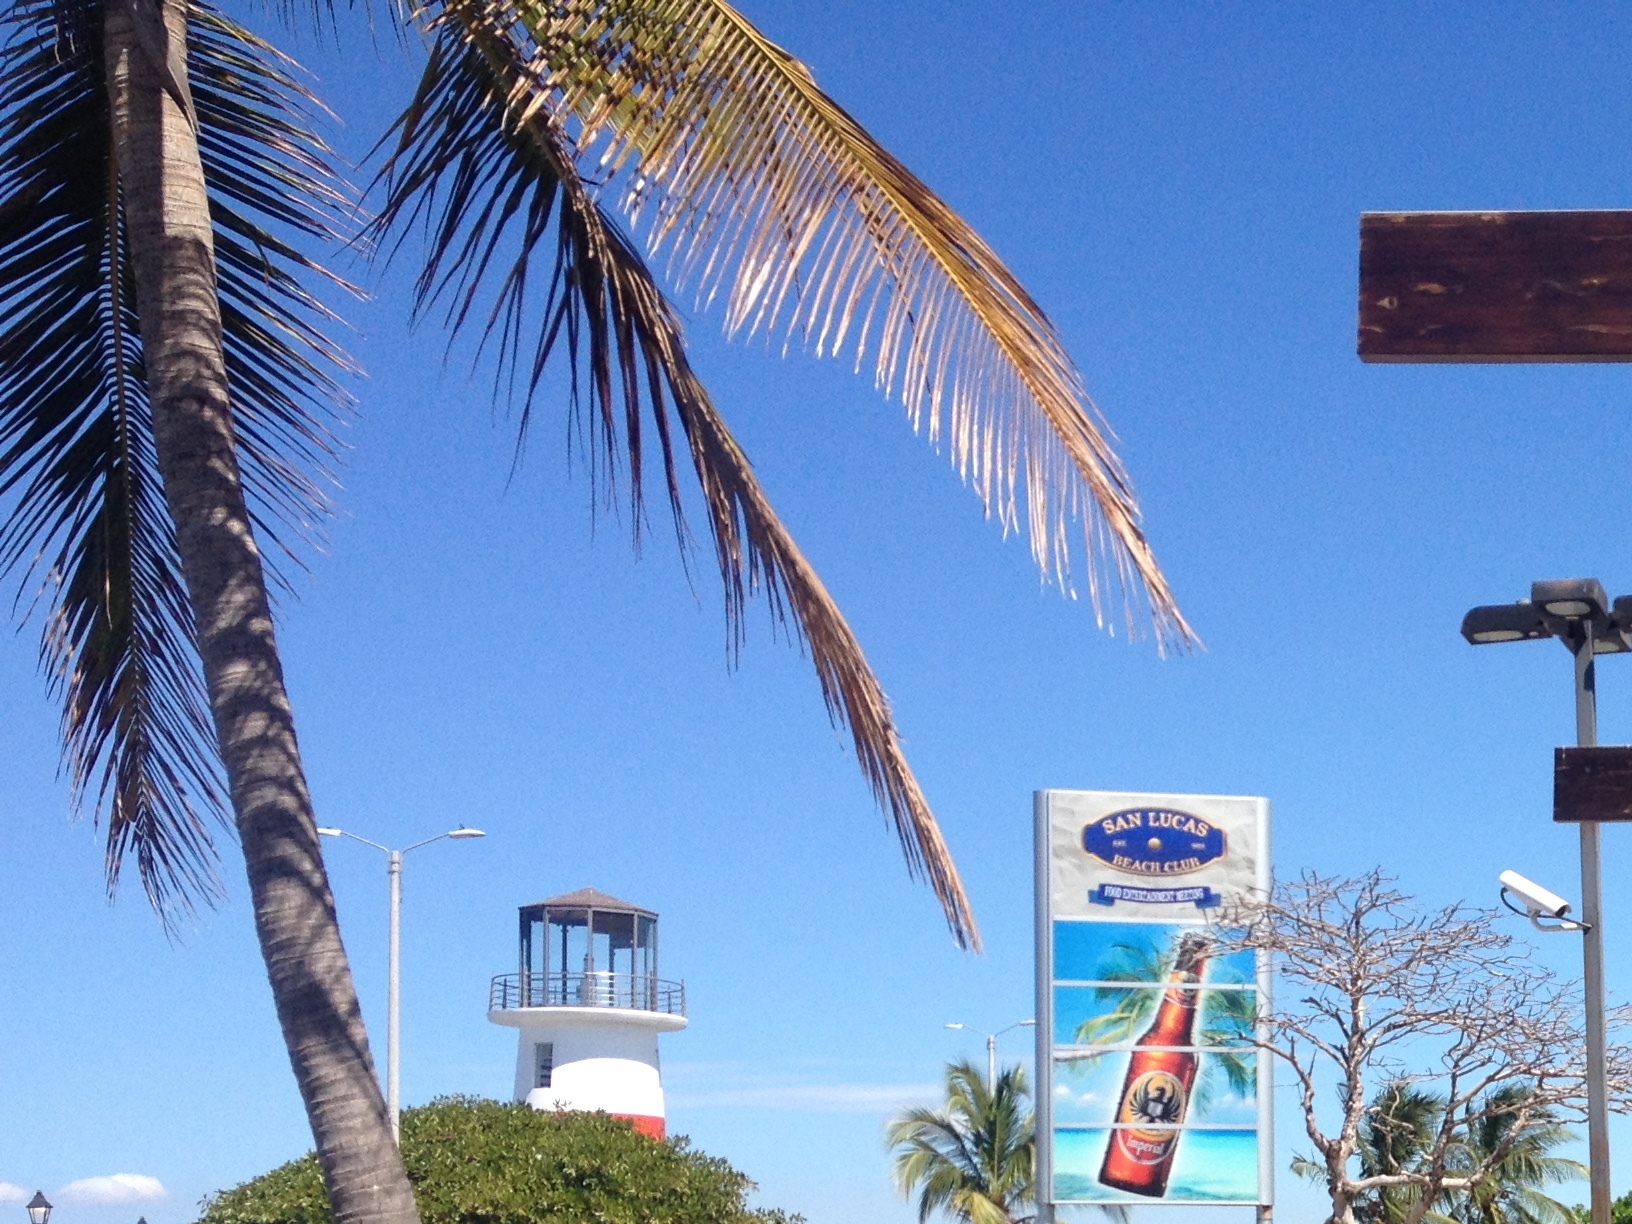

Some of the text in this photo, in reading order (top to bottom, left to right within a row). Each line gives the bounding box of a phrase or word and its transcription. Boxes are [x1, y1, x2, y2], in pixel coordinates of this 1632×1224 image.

[1102, 812, 1209, 837] SAN LUCAS
[1112, 854, 1200, 872] BEACH CLUB
